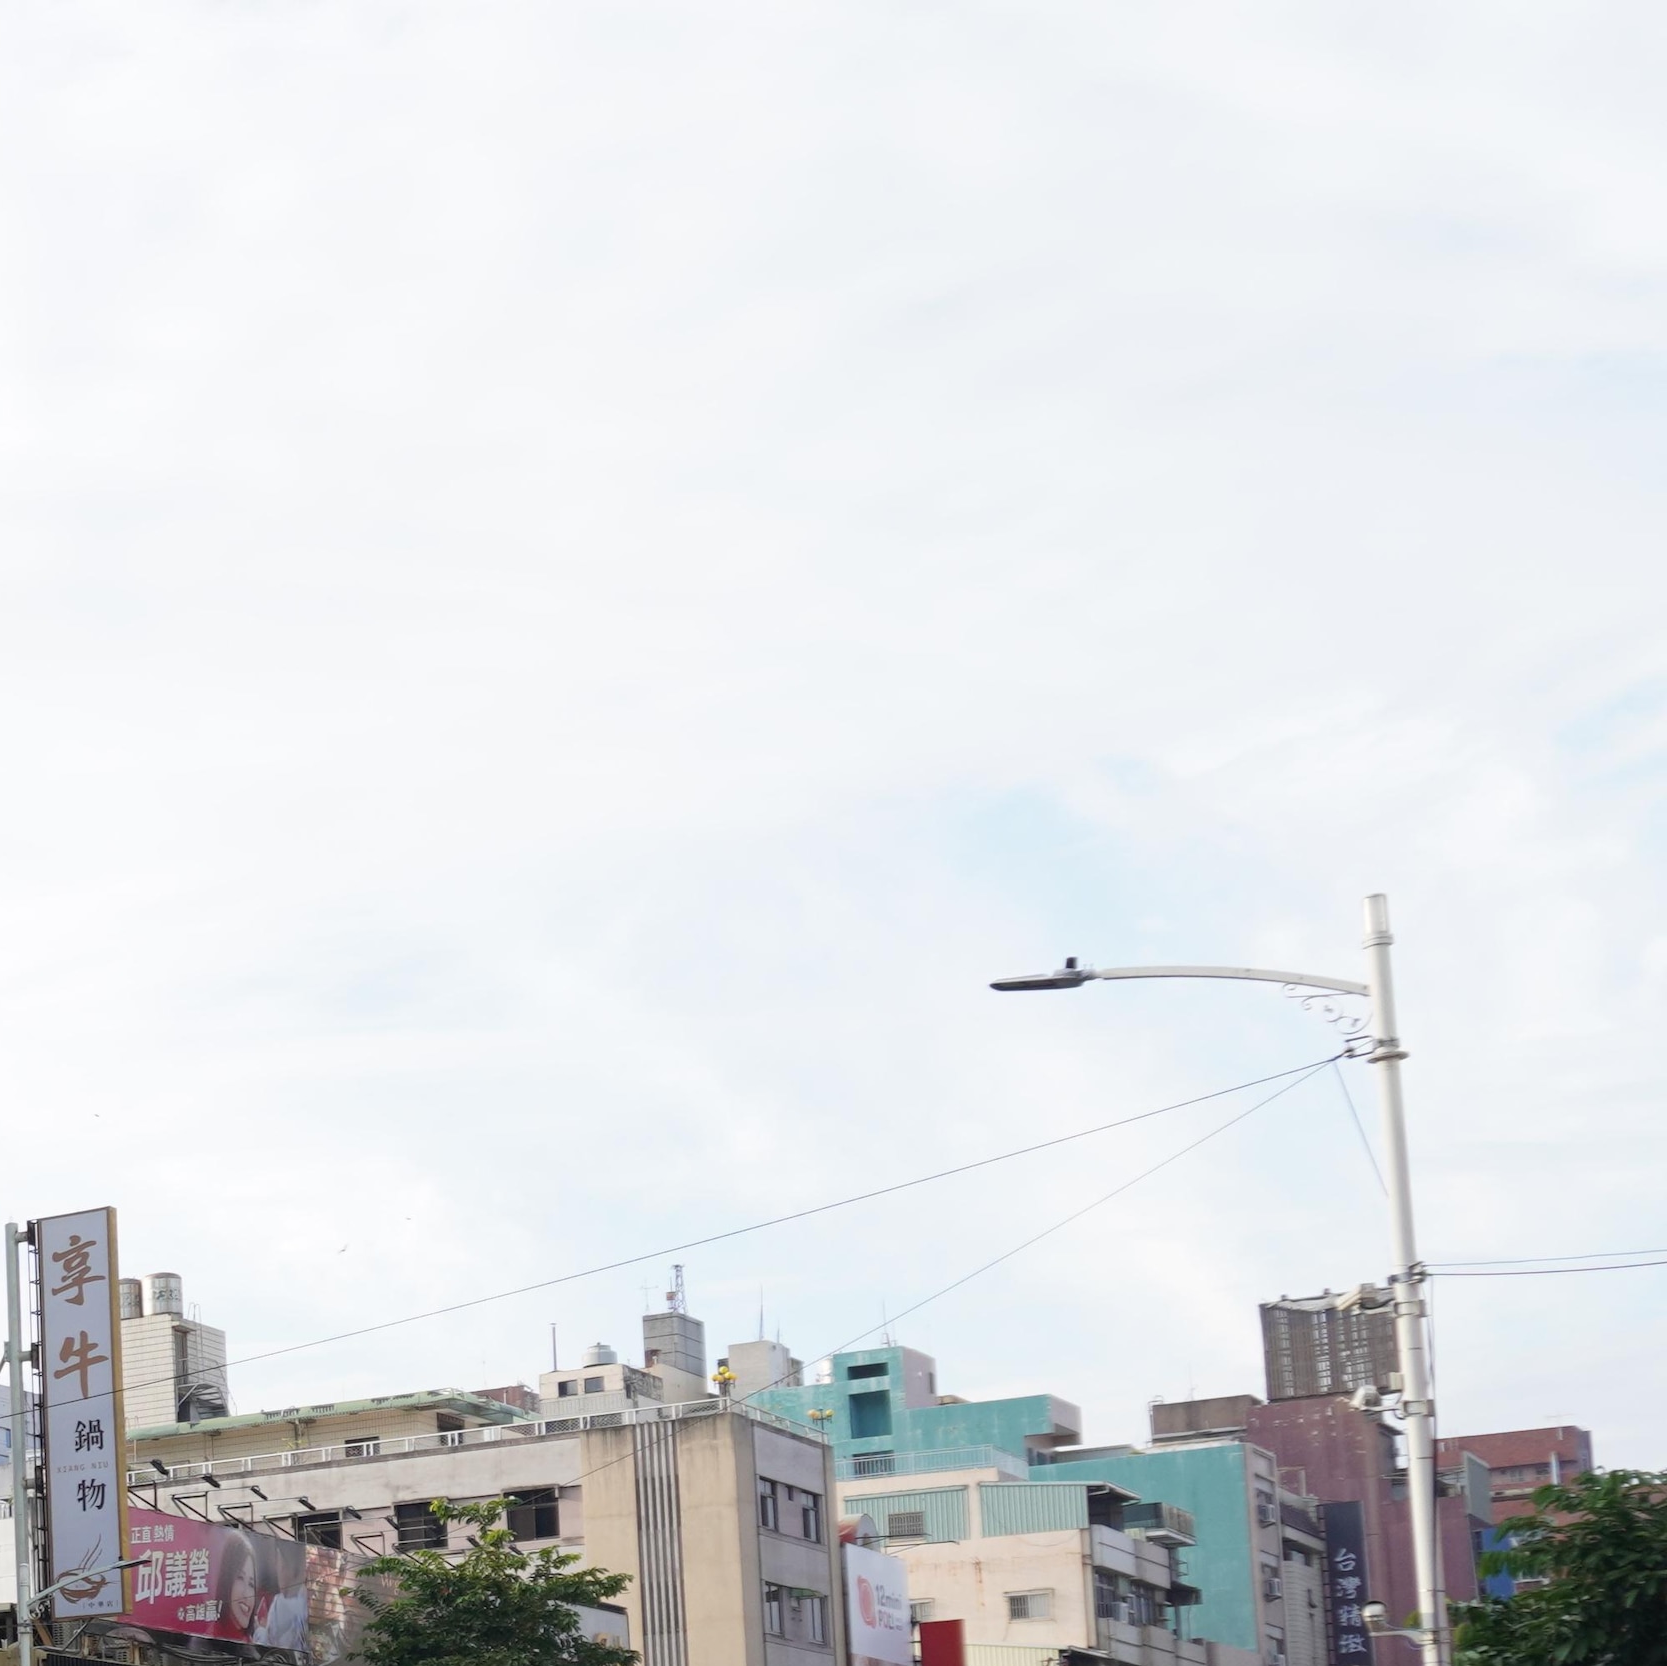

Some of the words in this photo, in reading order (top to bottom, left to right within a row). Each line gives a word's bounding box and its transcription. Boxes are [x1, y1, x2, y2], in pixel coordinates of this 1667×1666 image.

[51, 1235, 109, 1399] 享牛
[75, 1419, 106, 1513] 鍋物
[131, 1527, 151, 1543] 正直
